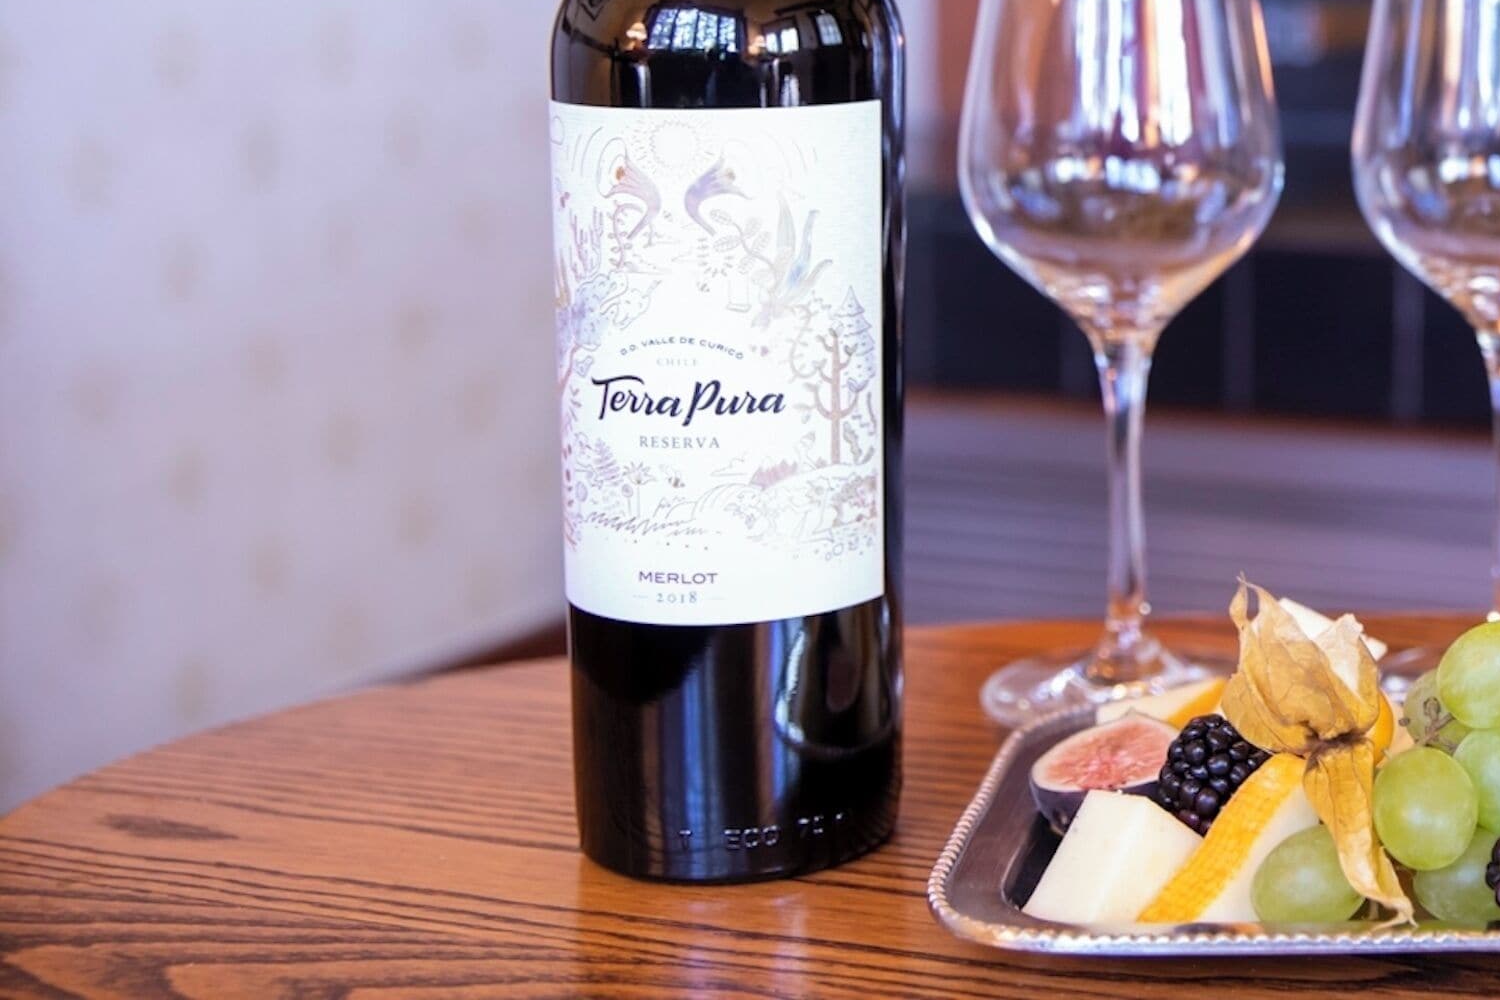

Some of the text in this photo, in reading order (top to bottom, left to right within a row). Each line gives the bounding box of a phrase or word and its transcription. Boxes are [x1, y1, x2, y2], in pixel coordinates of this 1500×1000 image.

[641, 336, 676, 347] VALLE
[679, 336, 696, 345] DE
[656, 358, 699, 368] CHILE
[591, 375, 786, 427] Terra Pura
[639, 435, 721, 449] RESERVA
[638, 571, 718, 585] MERLOT
[656, 591, 698, 604] 2018
